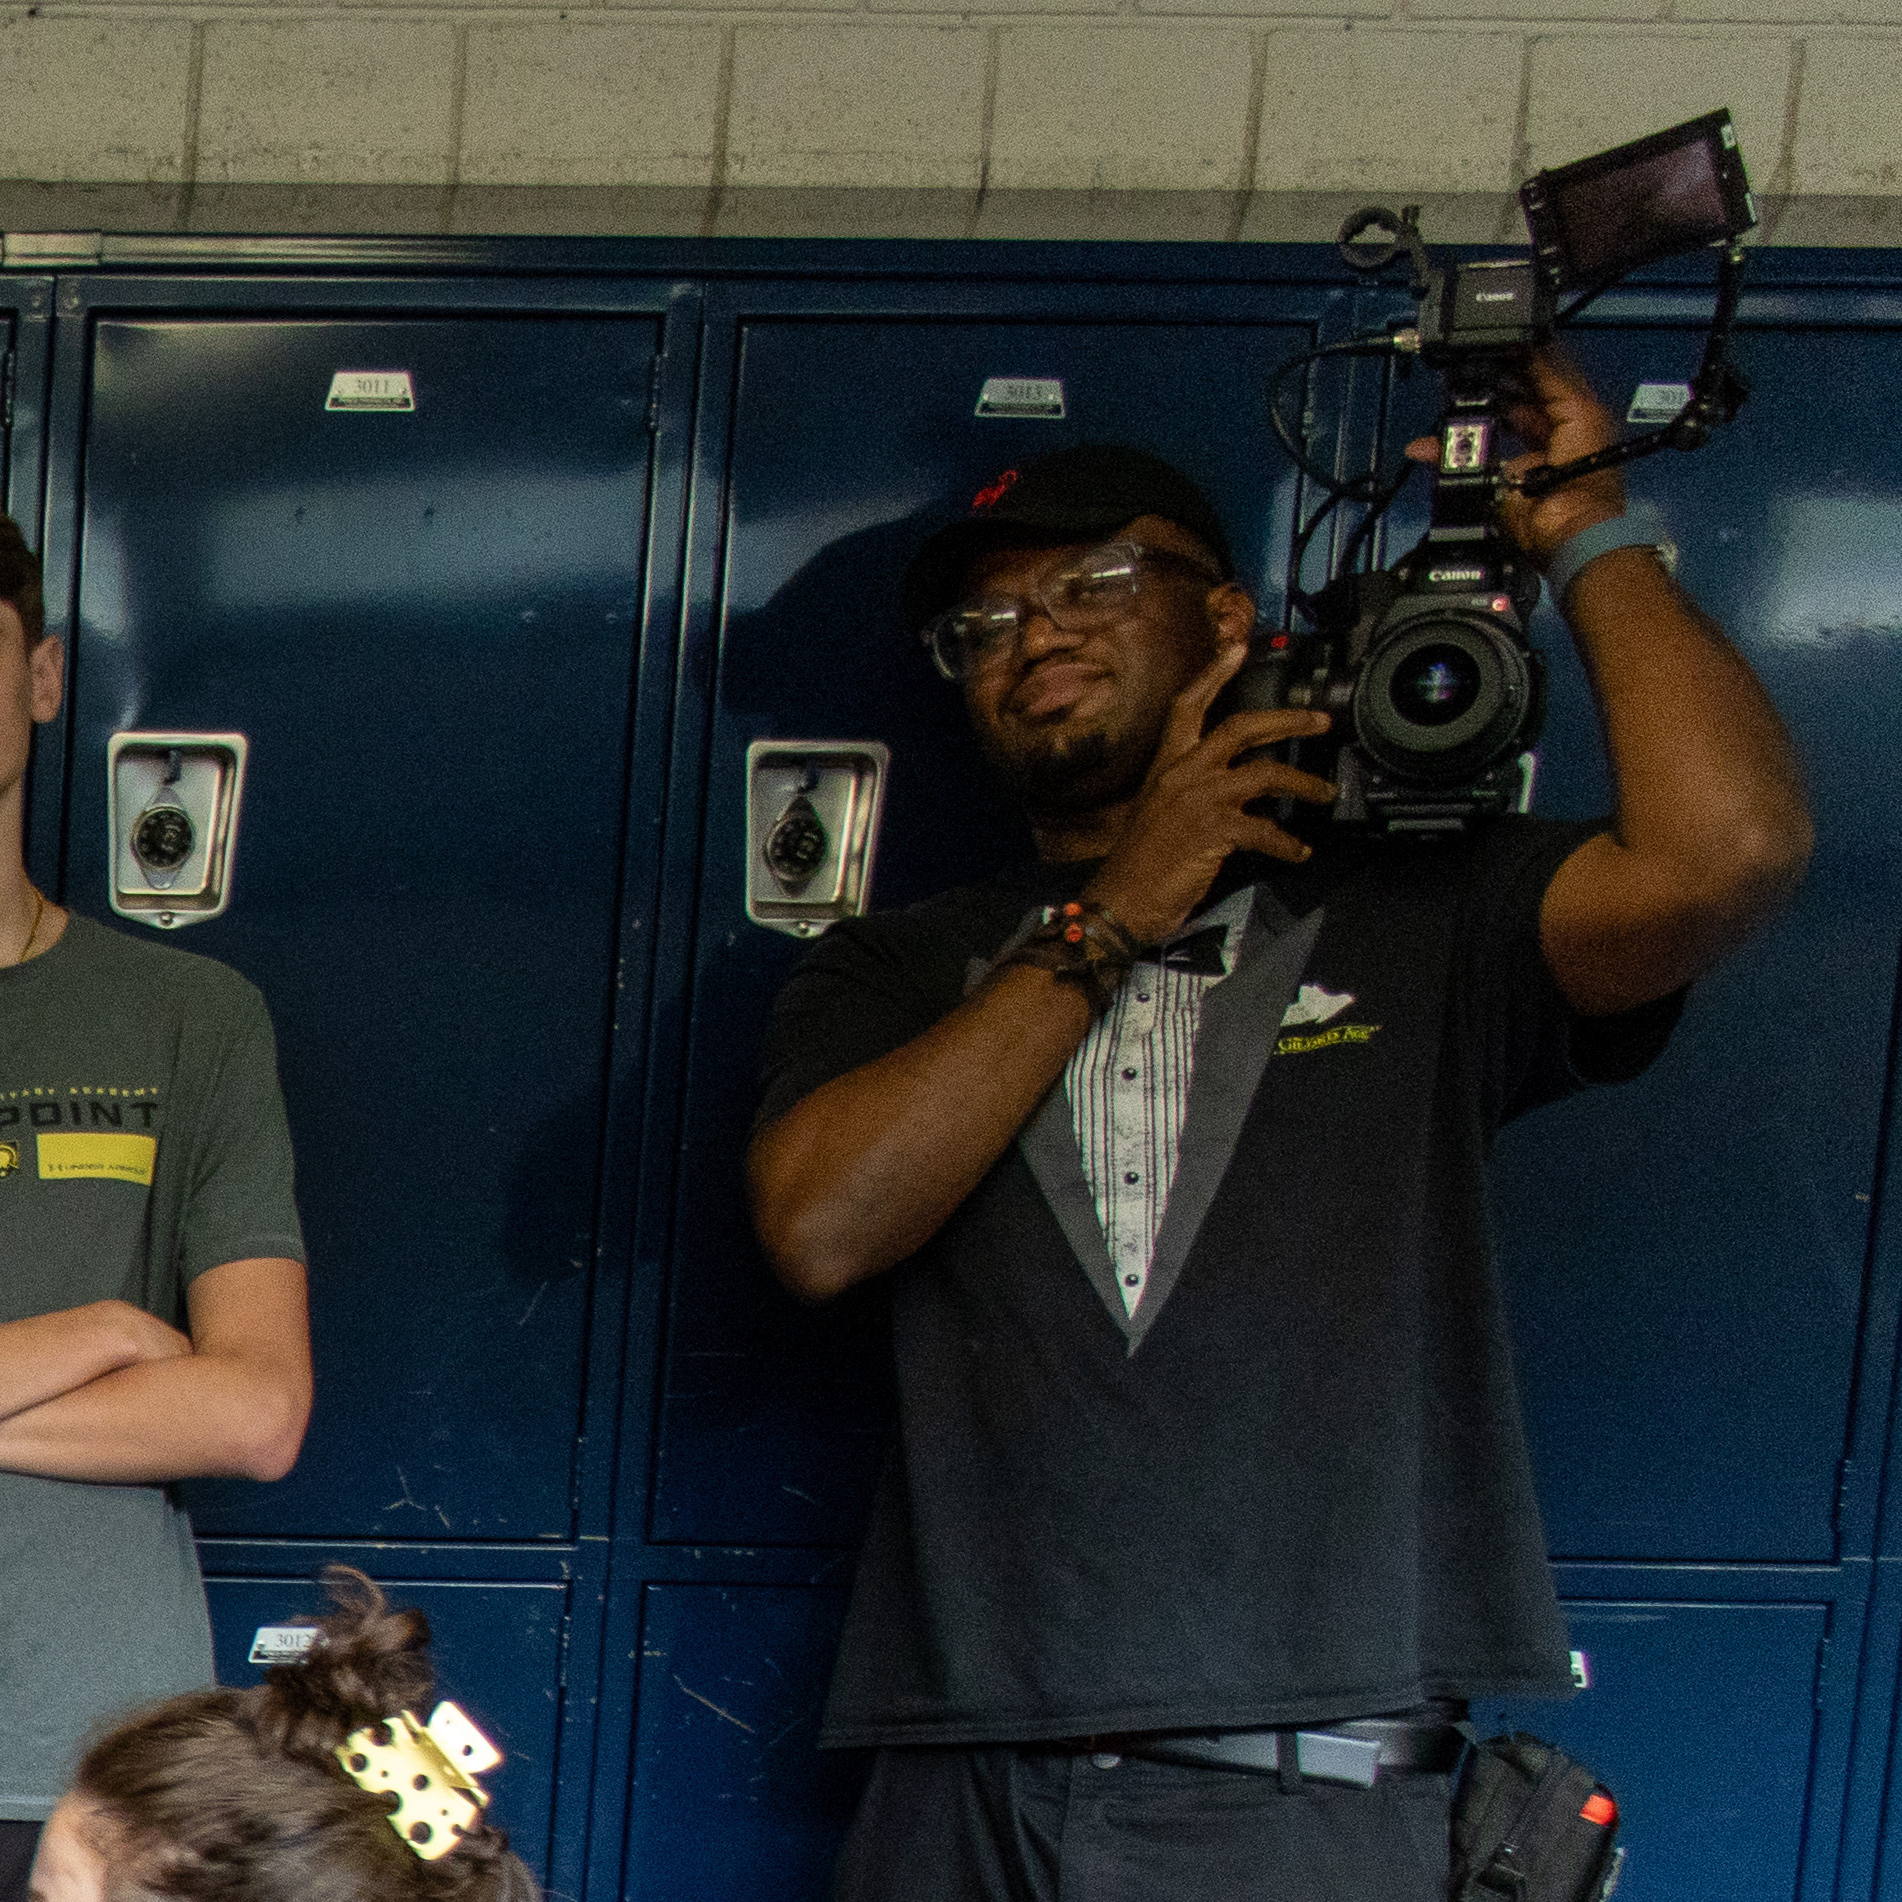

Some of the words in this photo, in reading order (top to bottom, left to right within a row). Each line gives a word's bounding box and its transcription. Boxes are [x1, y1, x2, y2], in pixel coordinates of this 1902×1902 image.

[358, 379, 389, 393] 3011
[1658, 388, 1686, 402] 301
[1429, 569, 1481, 582] Canon
